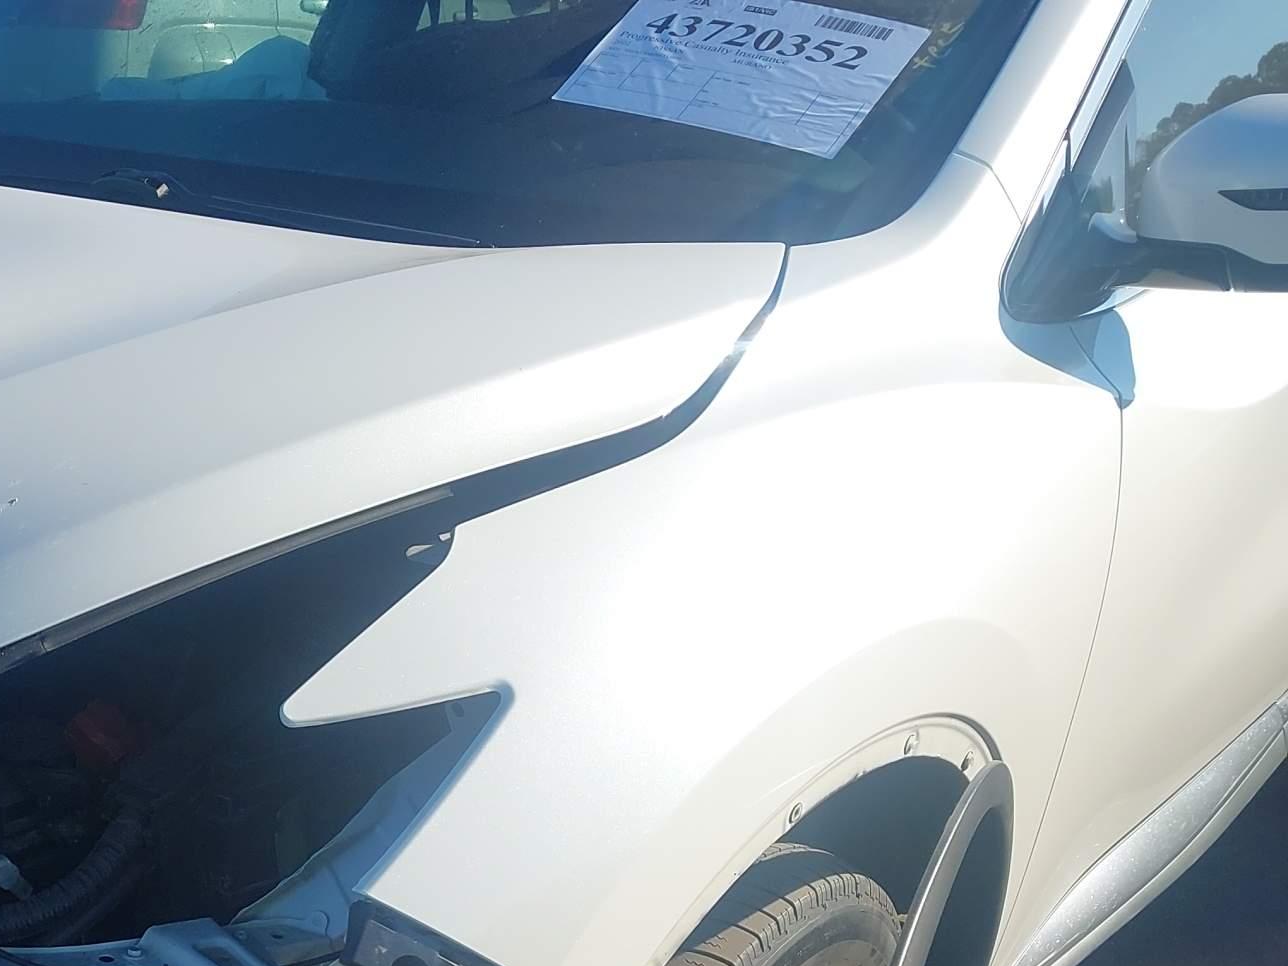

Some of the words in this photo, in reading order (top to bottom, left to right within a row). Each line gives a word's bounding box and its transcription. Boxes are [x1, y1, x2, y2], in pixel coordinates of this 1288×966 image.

[618, 30, 683, 46] Progressive
[684, 40, 731, 55] Casualty
[735, 48, 792, 65] Insurance
[645, 12, 868, 71] 43720352
